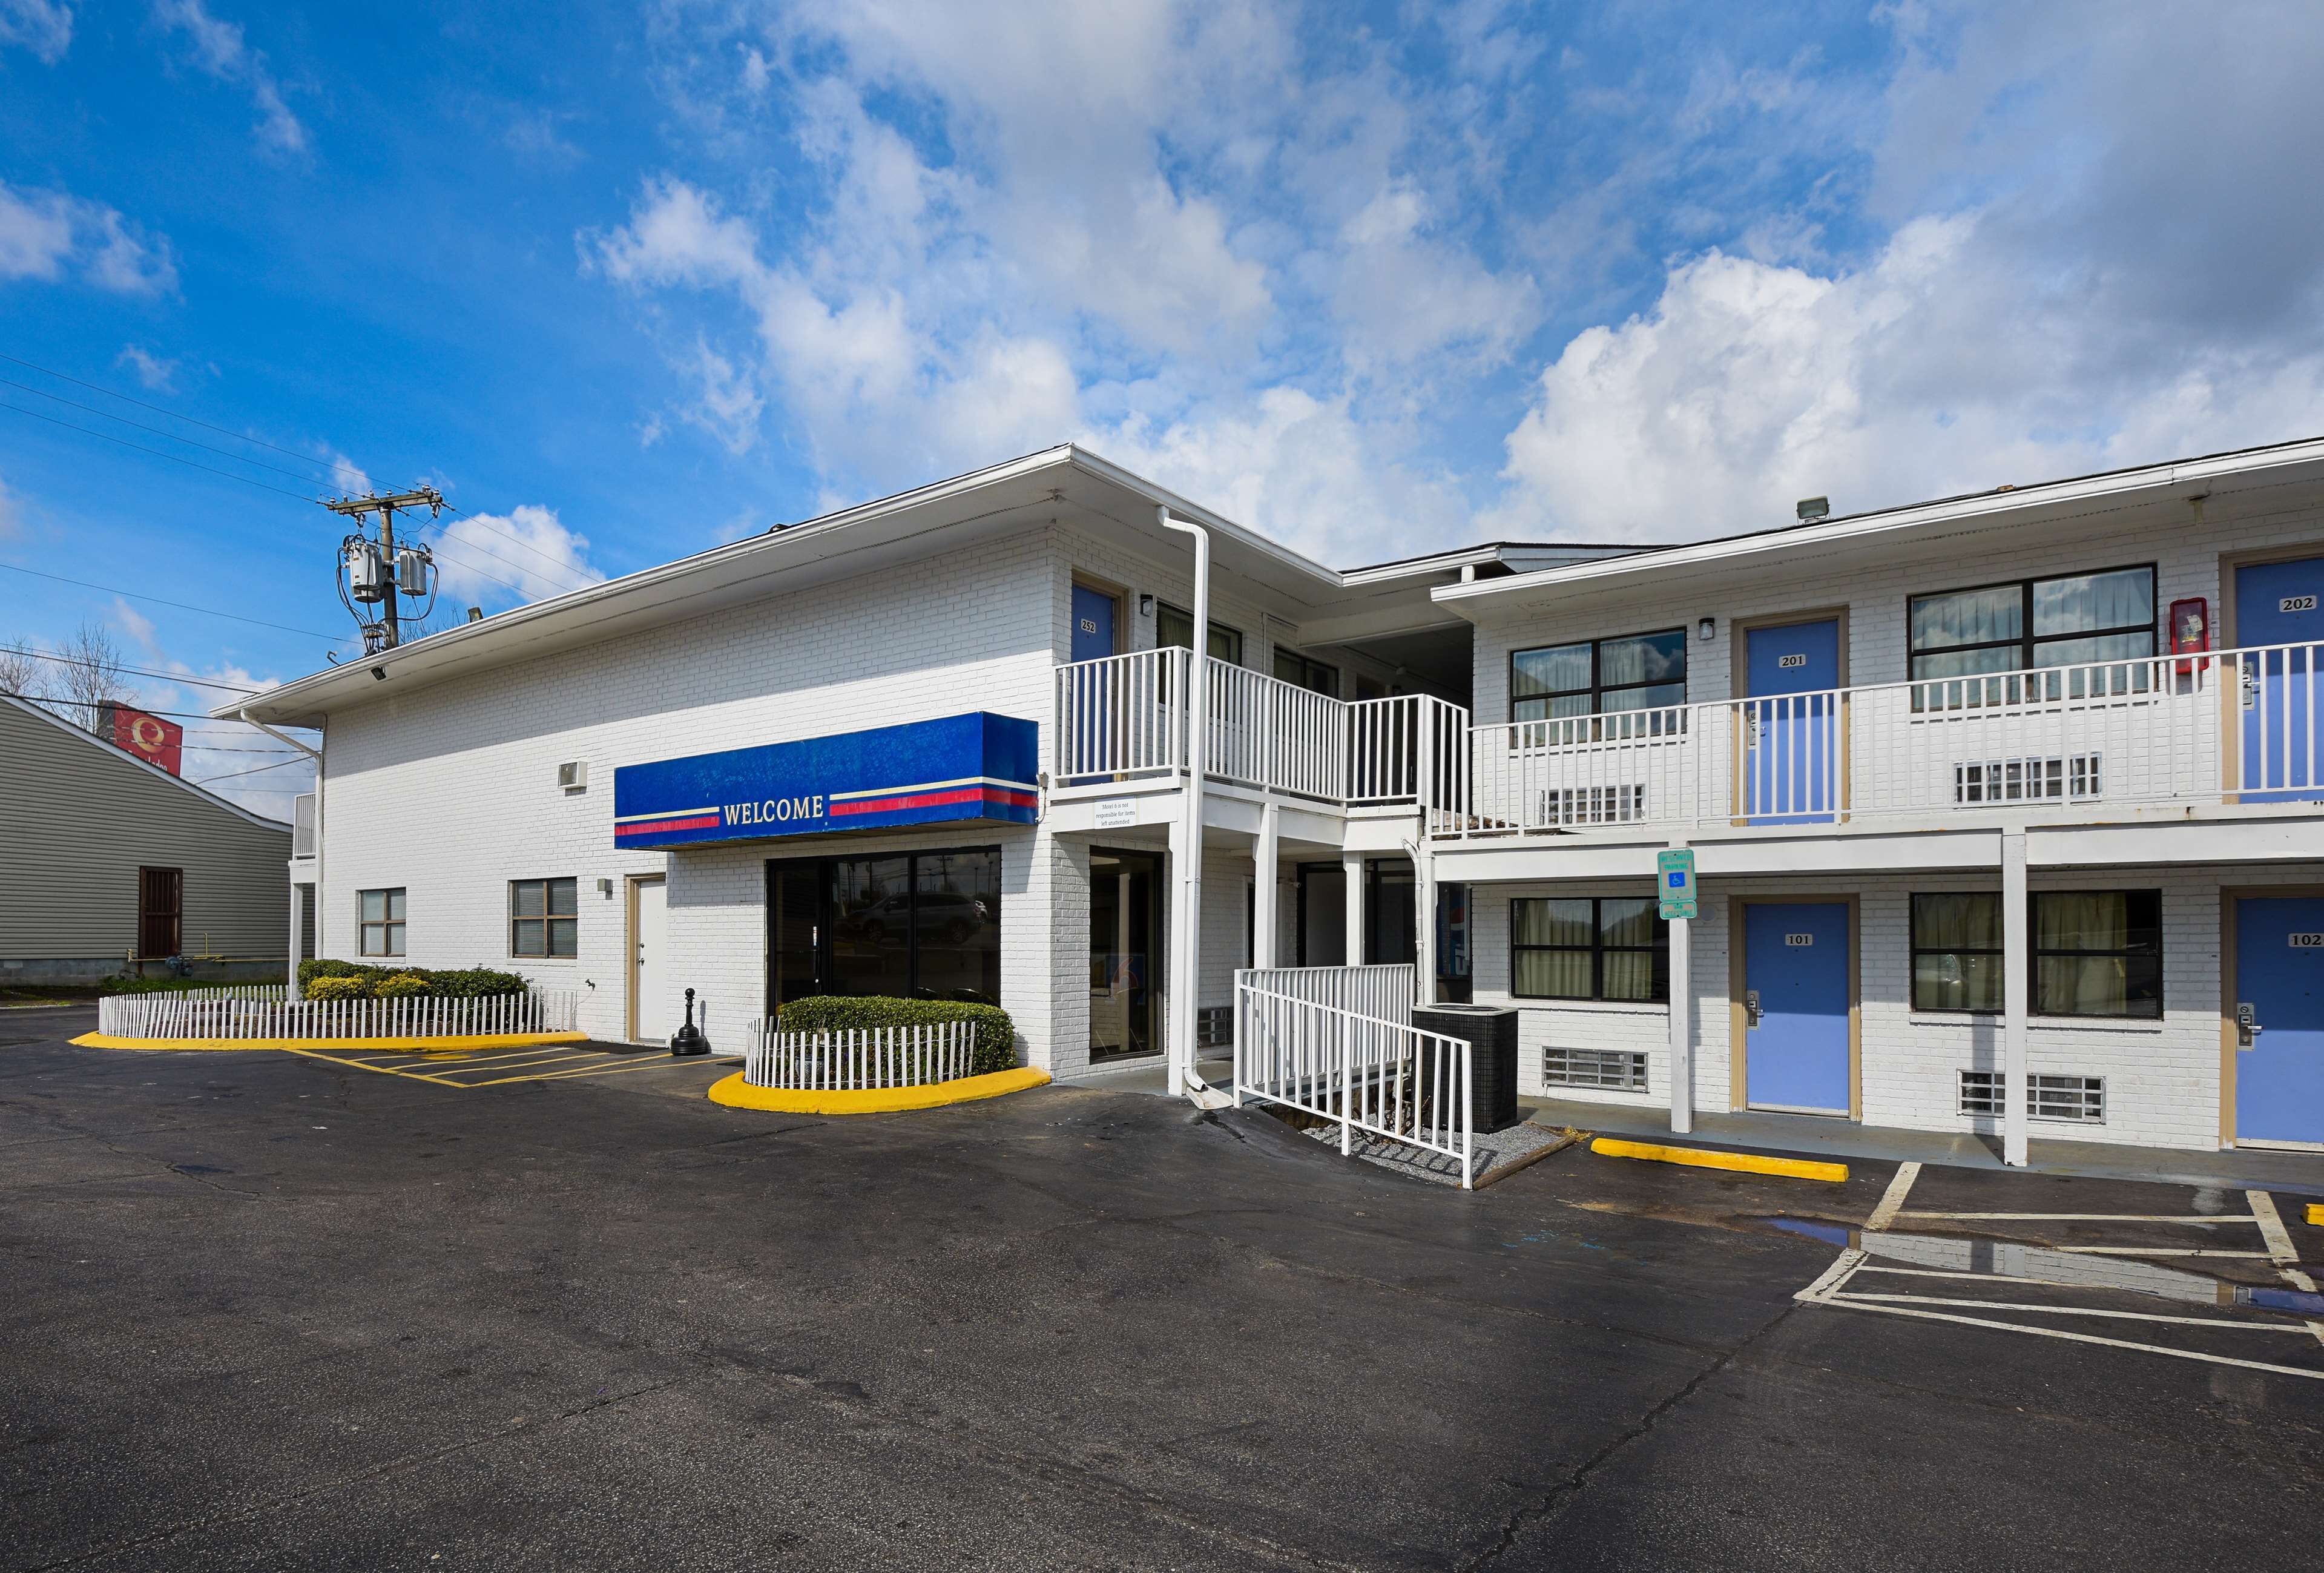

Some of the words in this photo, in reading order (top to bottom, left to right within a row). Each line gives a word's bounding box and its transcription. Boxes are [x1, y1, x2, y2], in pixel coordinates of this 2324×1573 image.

[2283, 598, 2313, 610] 202
[1082, 620, 1095, 632] 252
[1782, 656, 1802, 666] 201
[724, 795, 823, 825] WELCOME
[1789, 935, 1808, 945] 101
[2292, 935, 2322, 945] 102
